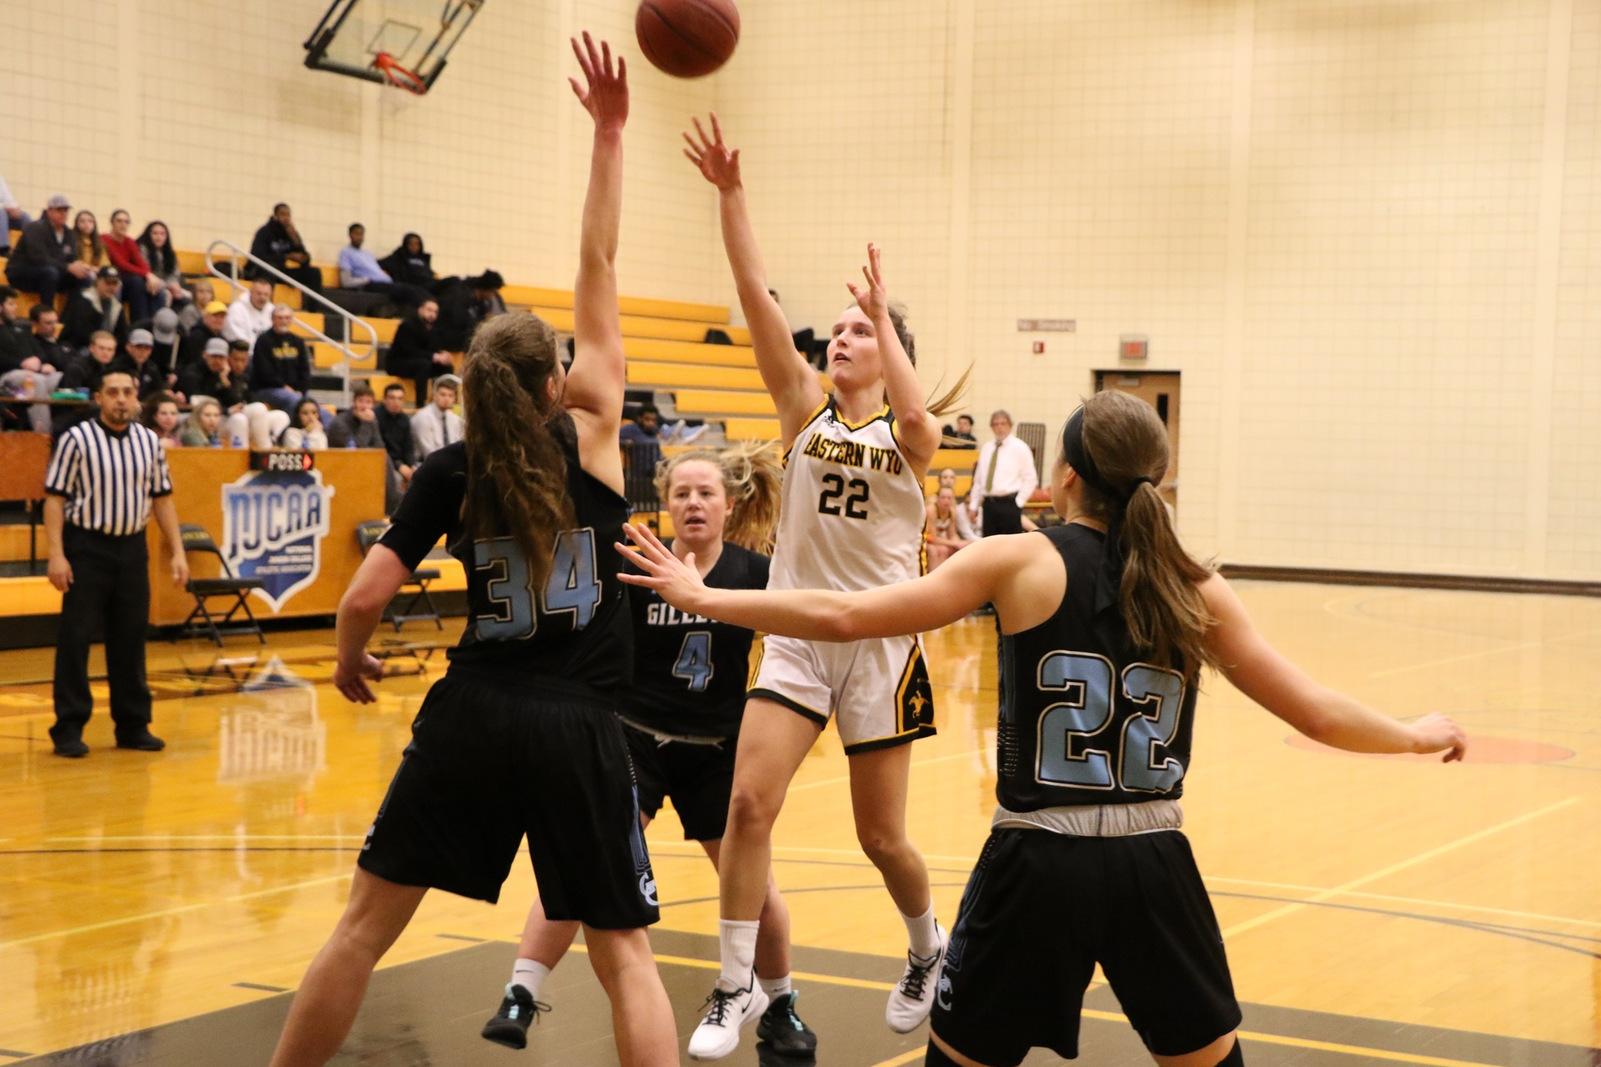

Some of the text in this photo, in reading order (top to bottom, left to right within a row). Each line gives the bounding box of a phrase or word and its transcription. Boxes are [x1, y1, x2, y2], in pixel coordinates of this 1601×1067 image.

[227, 488, 322, 560] NJCAA
[818, 472, 870, 520] 22
[474, 526, 603, 640] 34
[671, 630, 714, 692] 4
[1034, 649, 1186, 794] 22
